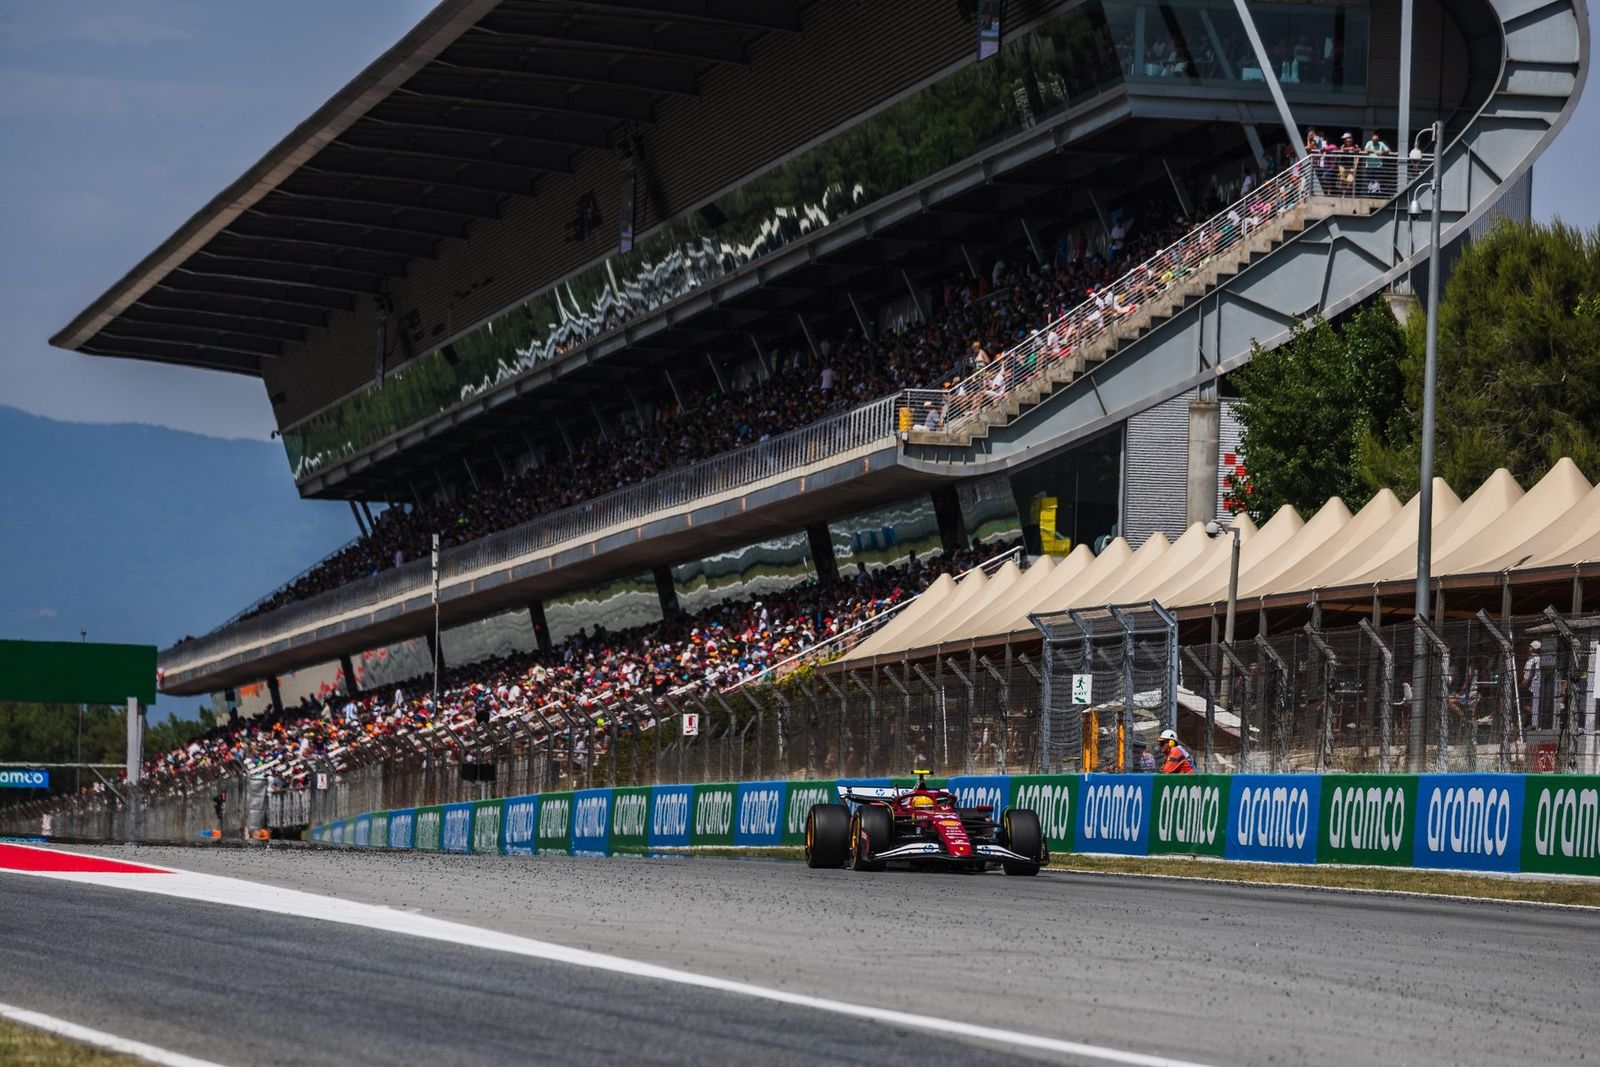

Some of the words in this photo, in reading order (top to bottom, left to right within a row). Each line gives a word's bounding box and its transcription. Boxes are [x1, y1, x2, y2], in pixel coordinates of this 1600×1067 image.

[654, 794, 688, 835] aramco
[696, 791, 732, 835] aramco
[740, 790, 779, 835] aramco
[1084, 785, 1143, 842] aramco
[1158, 785, 1220, 845] aramco
[1238, 787, 1309, 849] aramco
[1329, 786, 1405, 851] aramco
[1427, 787, 1510, 856] aramco
[1535, 788, 1600, 858] aram
